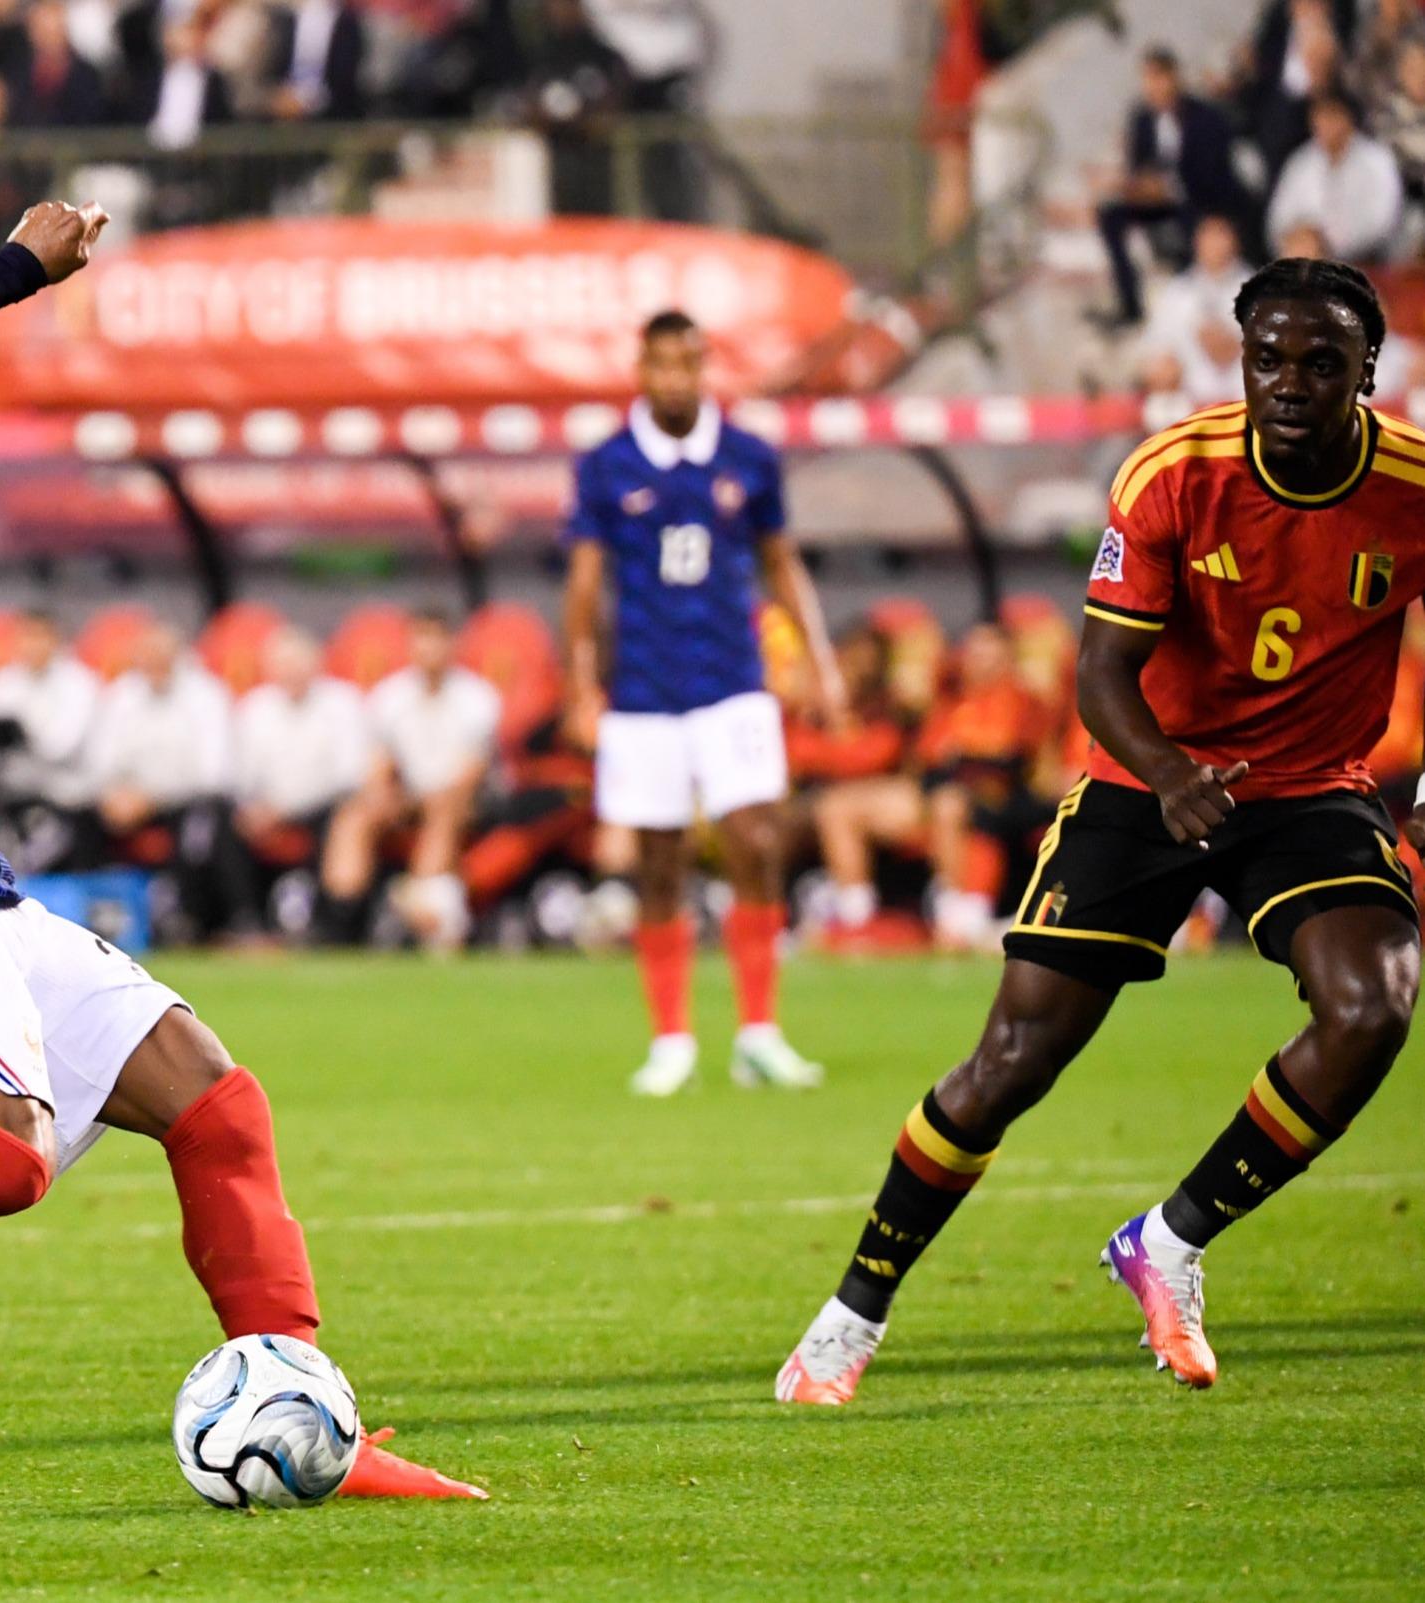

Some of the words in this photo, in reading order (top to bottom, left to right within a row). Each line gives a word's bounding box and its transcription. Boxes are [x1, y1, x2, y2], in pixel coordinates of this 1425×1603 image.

[99, 259, 239, 346] CITY
[246, 257, 330, 344] OF
[337, 250, 672, 340] BRUSSELS
[1251, 607, 1301, 681] 6
